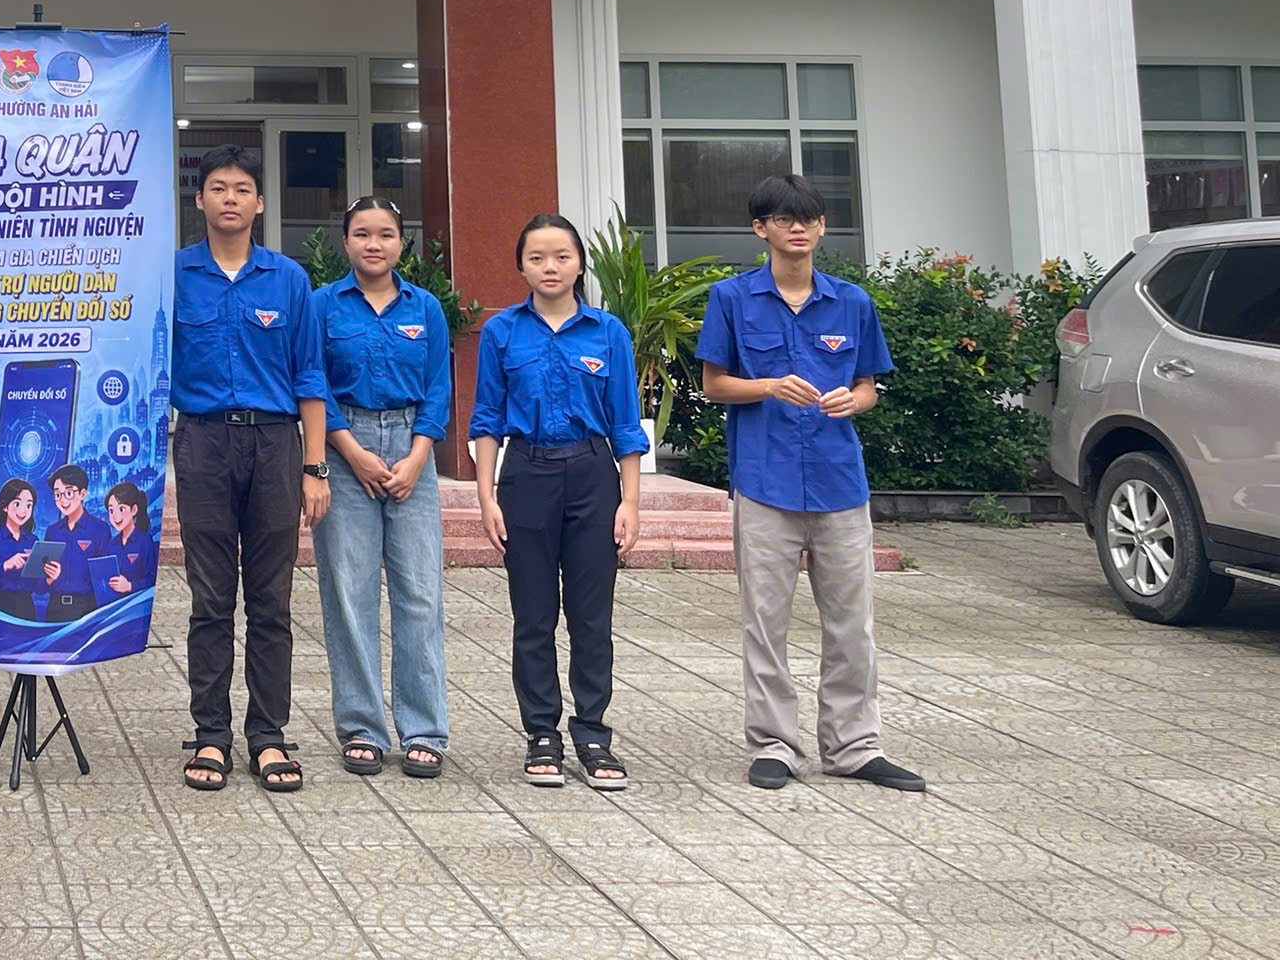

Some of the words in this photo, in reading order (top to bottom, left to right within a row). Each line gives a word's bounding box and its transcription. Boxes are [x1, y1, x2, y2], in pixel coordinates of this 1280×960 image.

[50, 104, 70, 119] AN
[74, 99, 98, 118] HẢI
[15, 123, 139, 180] QUÂN
[39, 180, 104, 207] HÌNH
[39, 213, 79, 239] TÌNH
[83, 212, 145, 240] NGUYỆN
[9, 249, 34, 267] GIA
[38, 243, 82, 266] CHIẾN
[86, 247, 121, 269] DỊCH
[27, 270, 81, 294] NGƯỜI
[83, 269, 118, 293] DÂN
[6, 296, 73, 322] CHUYỂN
[76, 293, 108, 322] ĐỔI
[109, 293, 133, 321] SỐ
[37, 332, 81, 348] 2026
